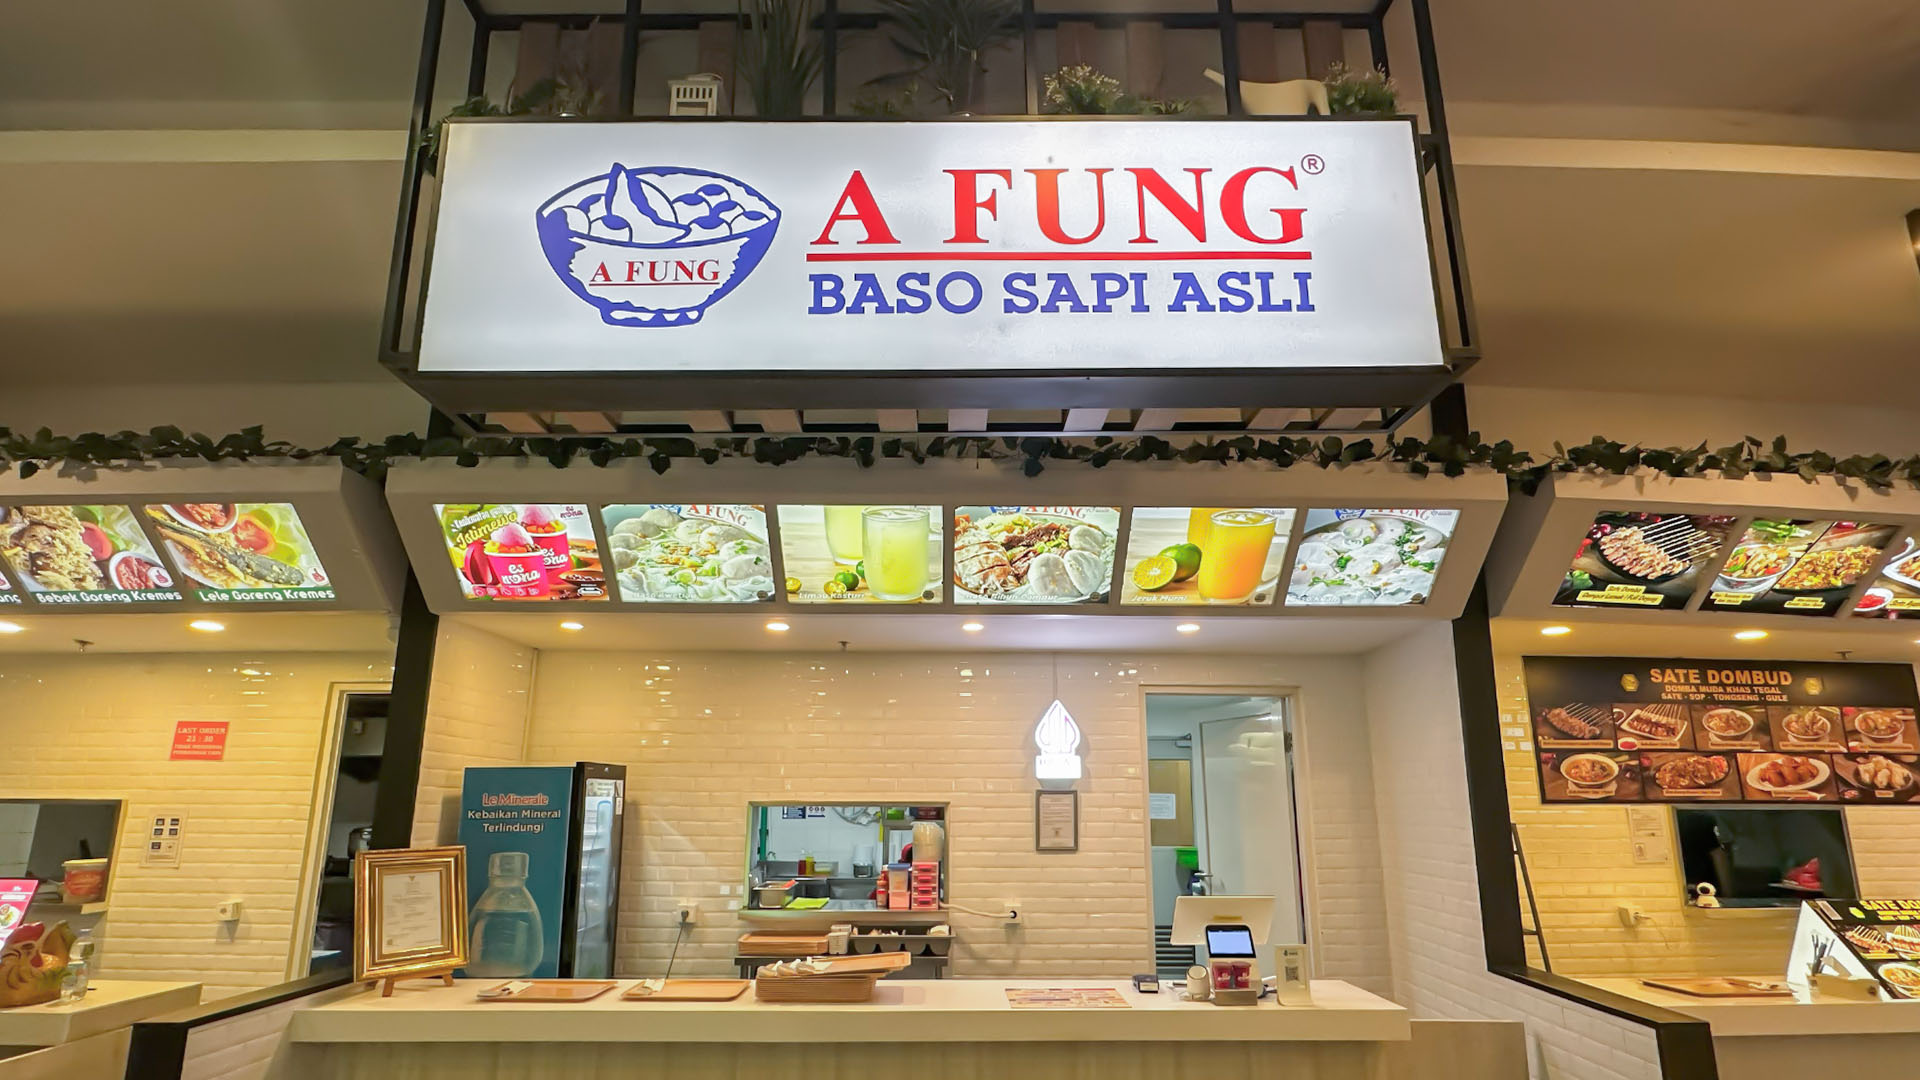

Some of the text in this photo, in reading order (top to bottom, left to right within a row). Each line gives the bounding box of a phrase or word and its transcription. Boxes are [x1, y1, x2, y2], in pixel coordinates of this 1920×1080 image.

[811, 170, 901, 245] A
[944, 167, 1306, 245] FUNG
[589, 259, 720, 283] A FUNG
[808, 271, 1315, 314] BASO SAPI ASLI
[508, 564, 525, 574] es
[501, 570, 541, 584] nona
[36, 590, 183, 603] Bebek Goreng Kremes
[199, 589, 336, 602] Lele Goreng Kremes
[1650, 668, 1793, 686] SATE DOMBUD
[1665, 684, 1698, 693] DOMBA
[1699, 685, 1724, 693] MUDA
[1753, 686, 1782, 694] TEGAL
[482, 792, 549, 807] Le Minerale
[467, 809, 561, 819] Kebaikan Mineral
[483, 822, 544, 834] Terlindungi
[1859, 900, 1899, 911] SATE
